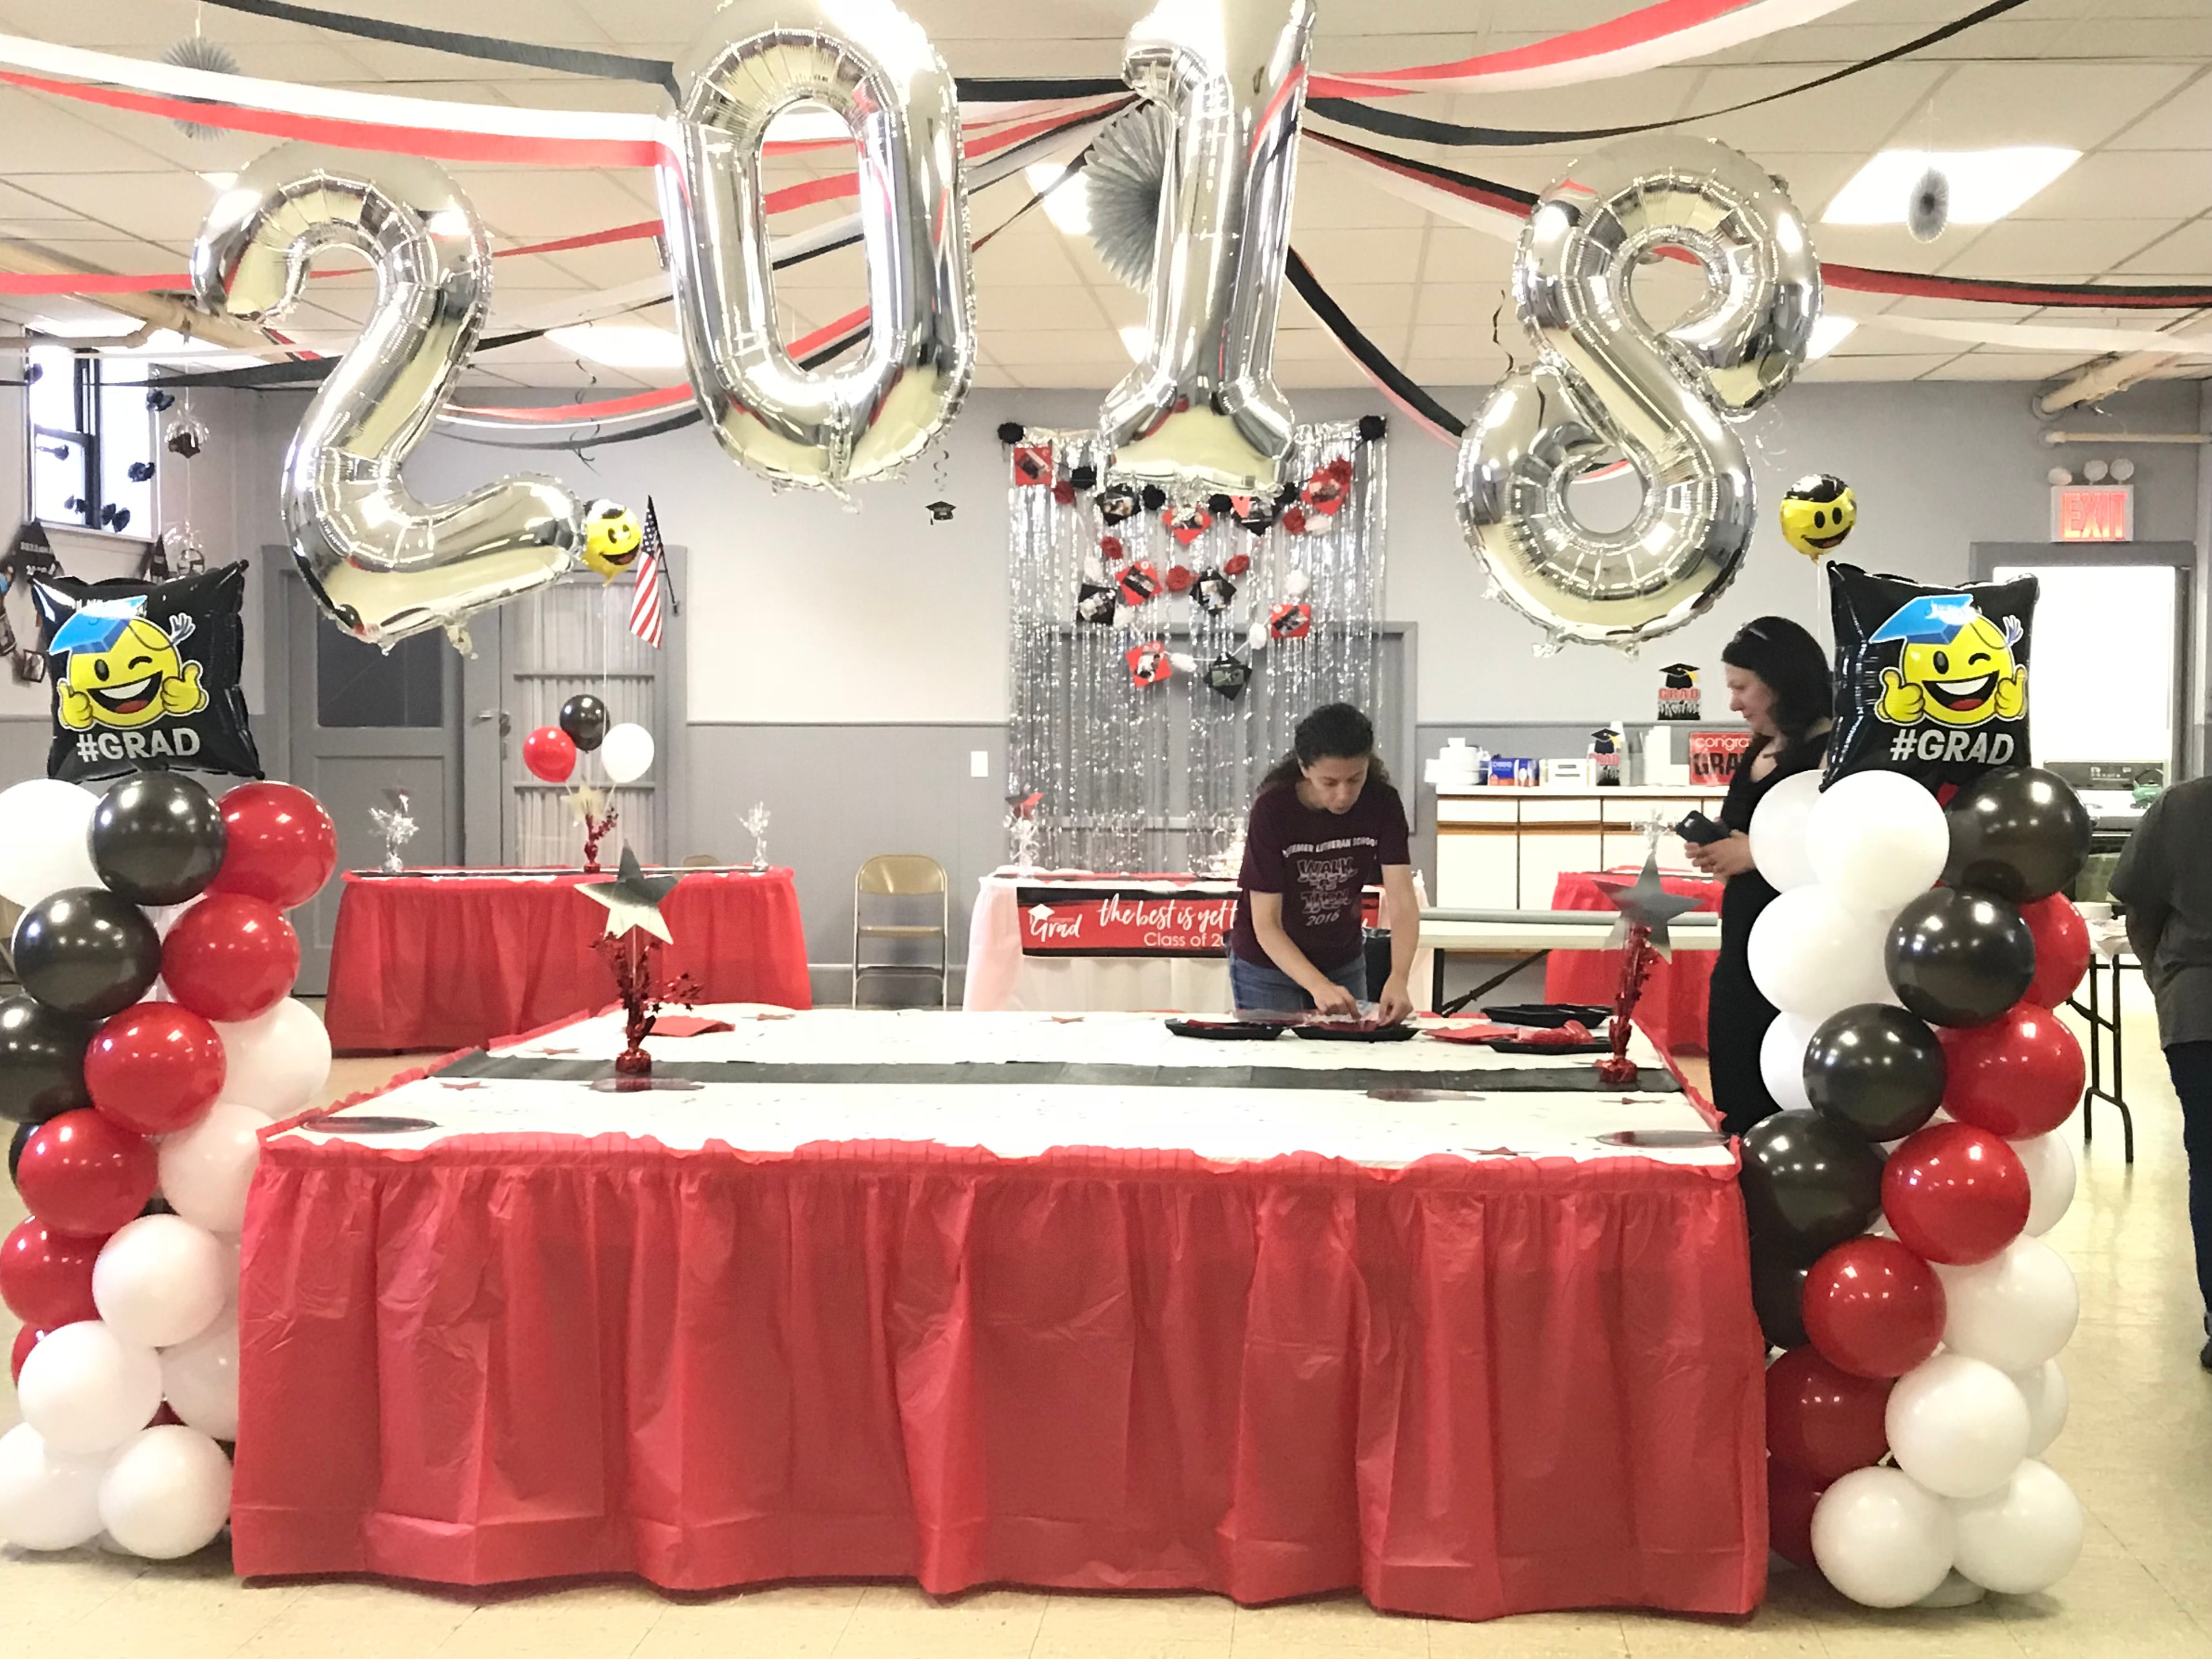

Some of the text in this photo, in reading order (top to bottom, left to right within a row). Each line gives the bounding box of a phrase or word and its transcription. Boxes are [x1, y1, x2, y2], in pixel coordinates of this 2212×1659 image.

[189, 0, 1824, 657] 2018
[2063, 492, 2127, 538] EXIT
[76, 728, 200, 763] #GRAD
[1694, 737, 1749, 751] congra
[1890, 729, 2014, 765] #GRAD
[1694, 752, 1742, 775] GRA
[1297, 857, 1358, 883] WALK
[1096, 893, 1238, 933] the best is yet t
[1305, 910, 1341, 927] 2016
[1030, 914, 1082, 942] Grad
[1143, 932, 1185, 947] Class
[1190, 930, 1207, 947] of
